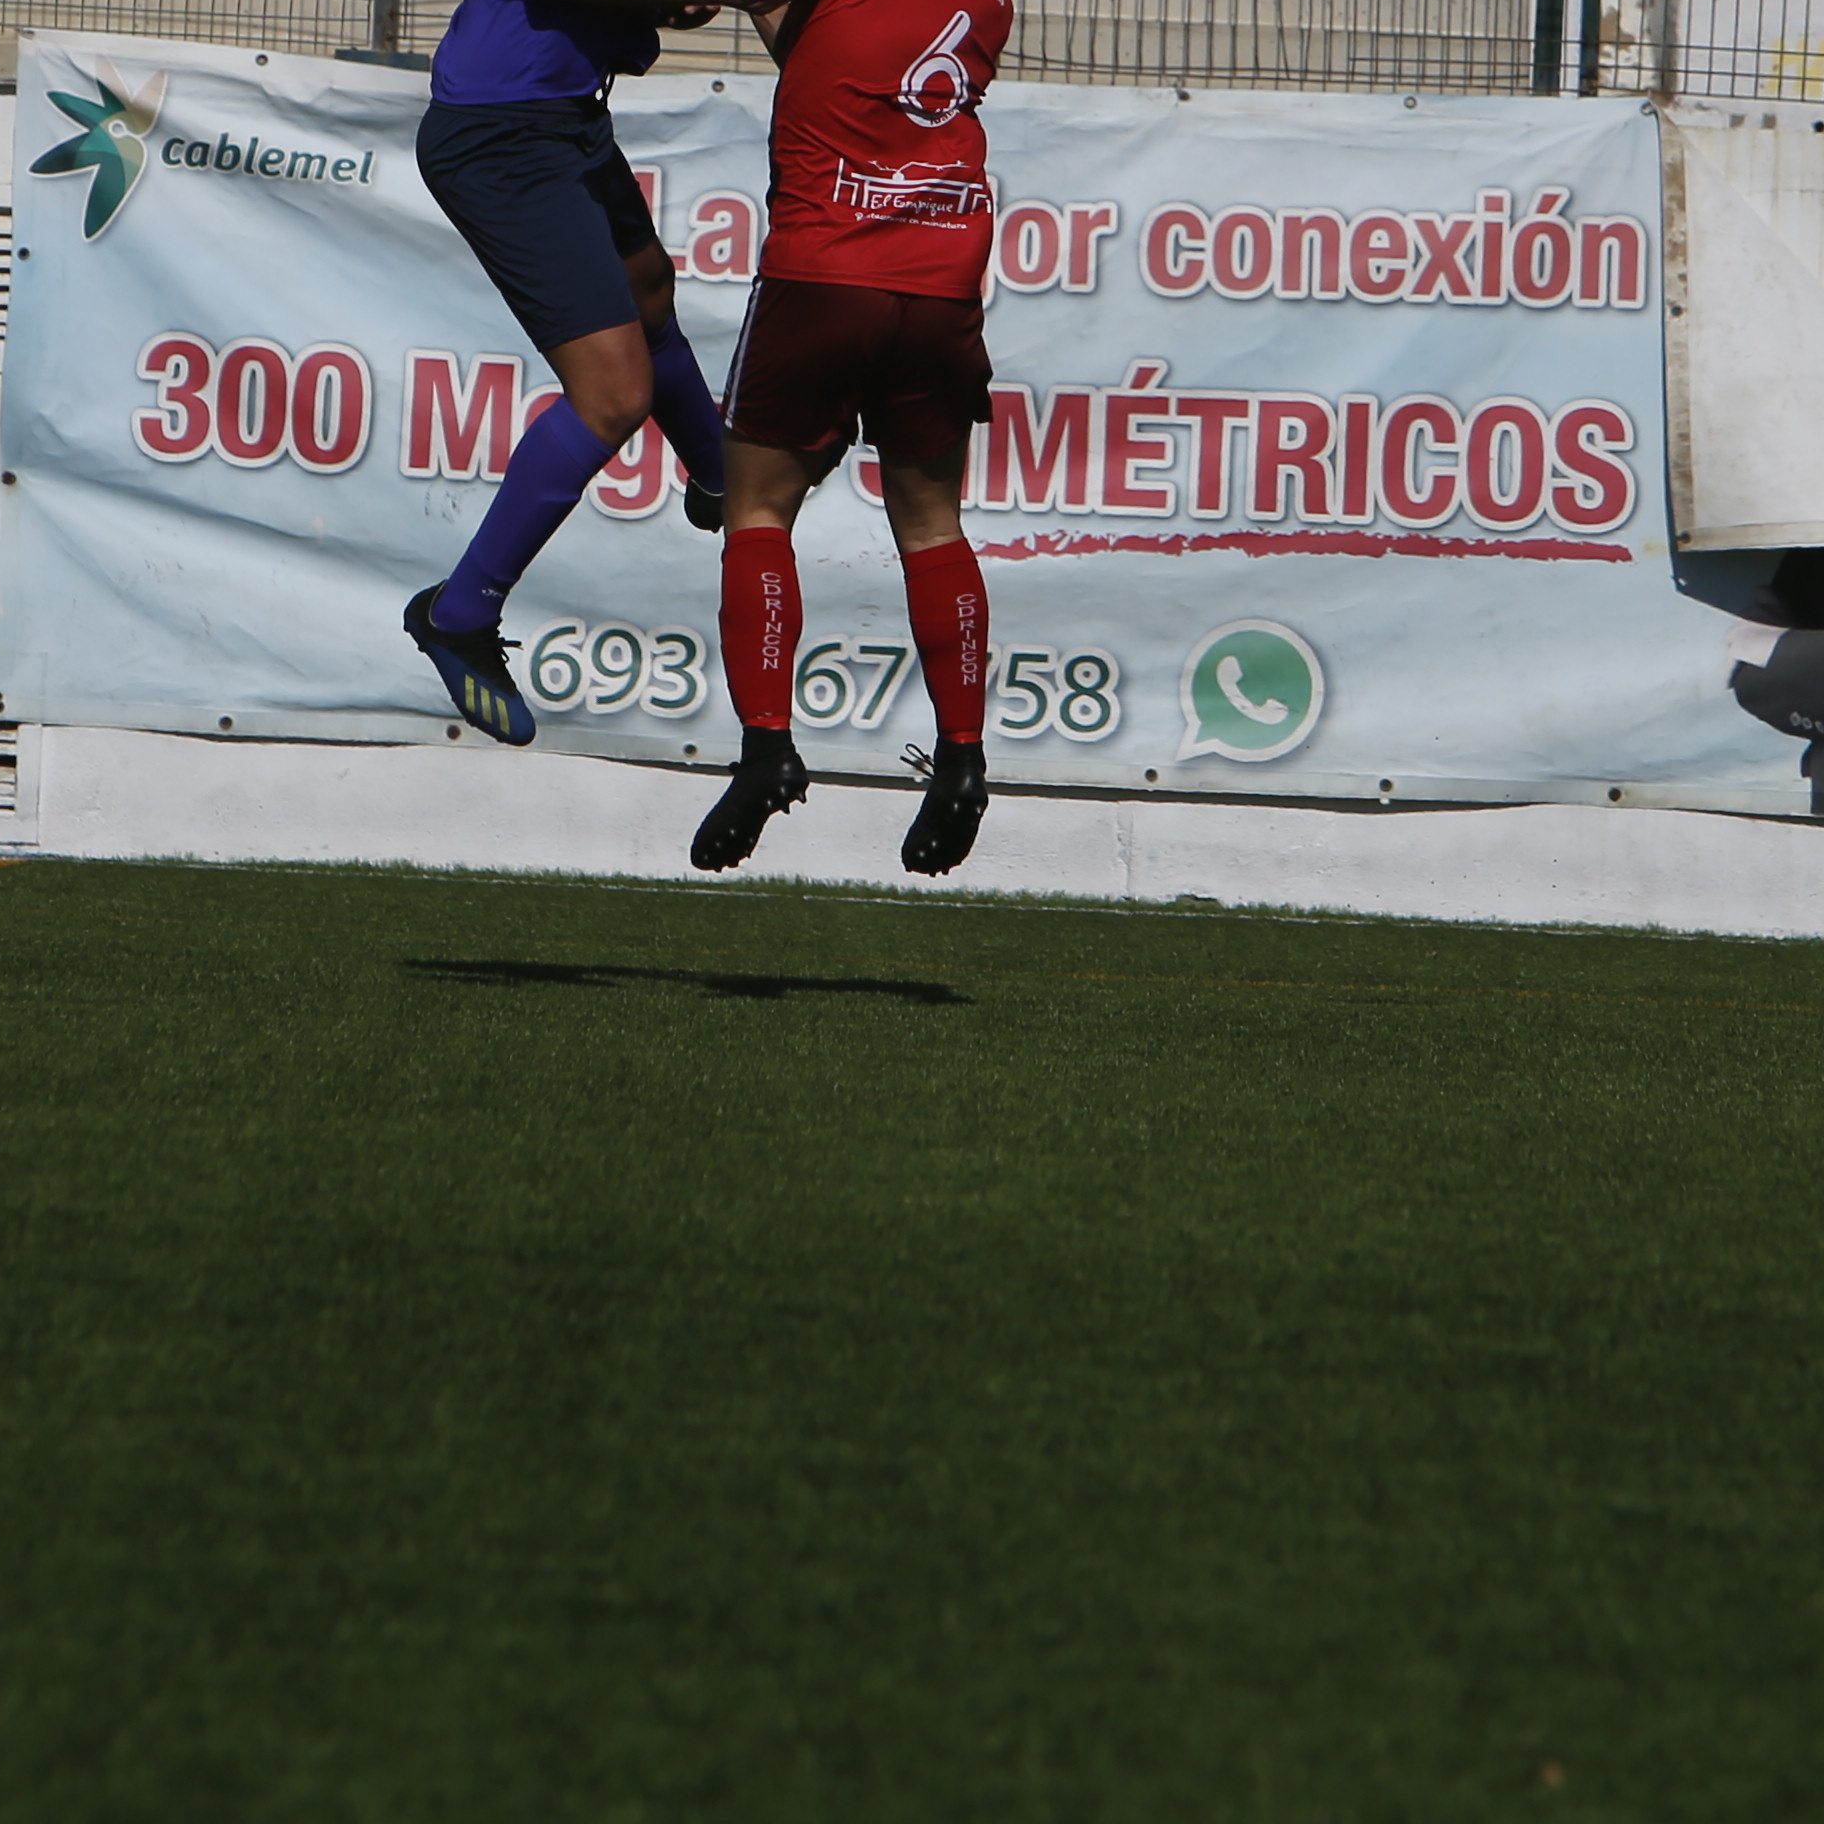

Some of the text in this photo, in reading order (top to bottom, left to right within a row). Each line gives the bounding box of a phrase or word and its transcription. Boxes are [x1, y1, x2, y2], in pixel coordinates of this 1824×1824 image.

[897, 10, 972, 128] 6
[161, 131, 374, 184] cablemel
[1146, 194, 1640, 302] conexión
[138, 339, 363, 465] 300
[858, 367, 1633, 525] MÉTRICOS
[530, 625, 697, 709] 693
[985, 648, 1111, 733] 58
